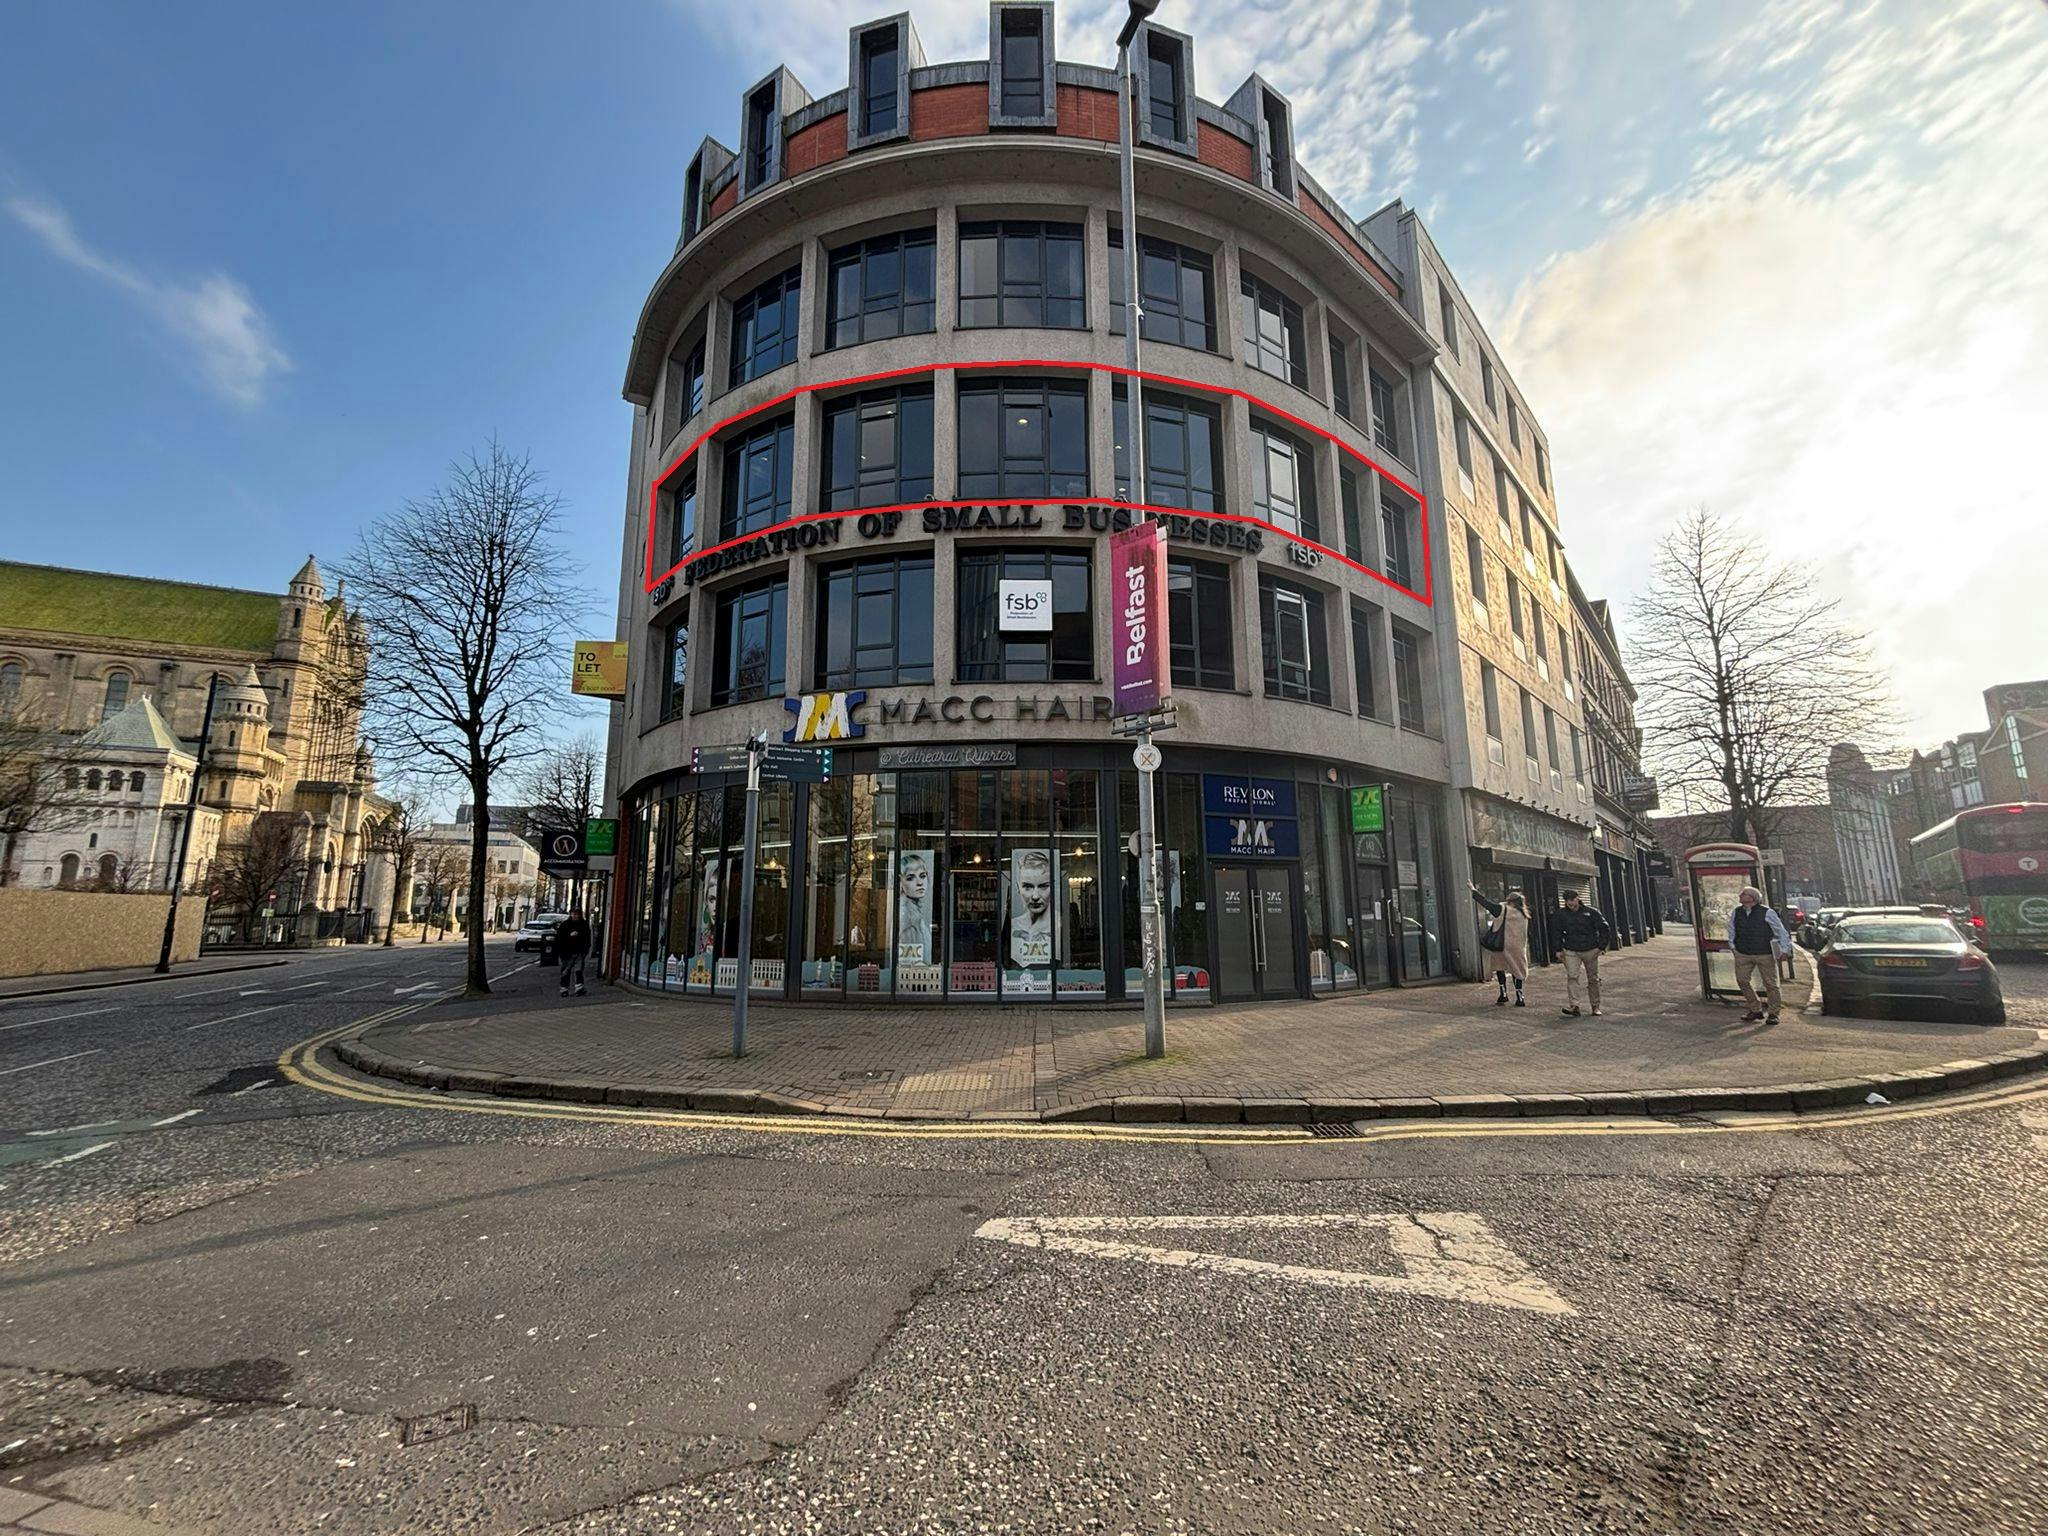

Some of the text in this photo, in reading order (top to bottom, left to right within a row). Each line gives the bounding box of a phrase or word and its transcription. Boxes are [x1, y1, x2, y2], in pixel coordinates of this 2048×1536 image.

[684, 517, 843, 586] FEDERATION
[857, 511, 902, 538] OF
[922, 504, 1042, 532] SMALL
[1005, 593, 1038, 610] fsb
[1125, 565, 1146, 666] Belfast
[578, 652, 596, 662] TO
[577, 663, 601, 673] LET
[880, 694, 1113, 725] MACC HAIR
[897, 746, 959, 765] Cathedral
[962, 746, 1017, 765] Quarter
[1223, 785, 1275, 801] REVLON
[1230, 846, 1276, 856] MACC HAIR
[1705, 852, 1736, 860] Telephone
